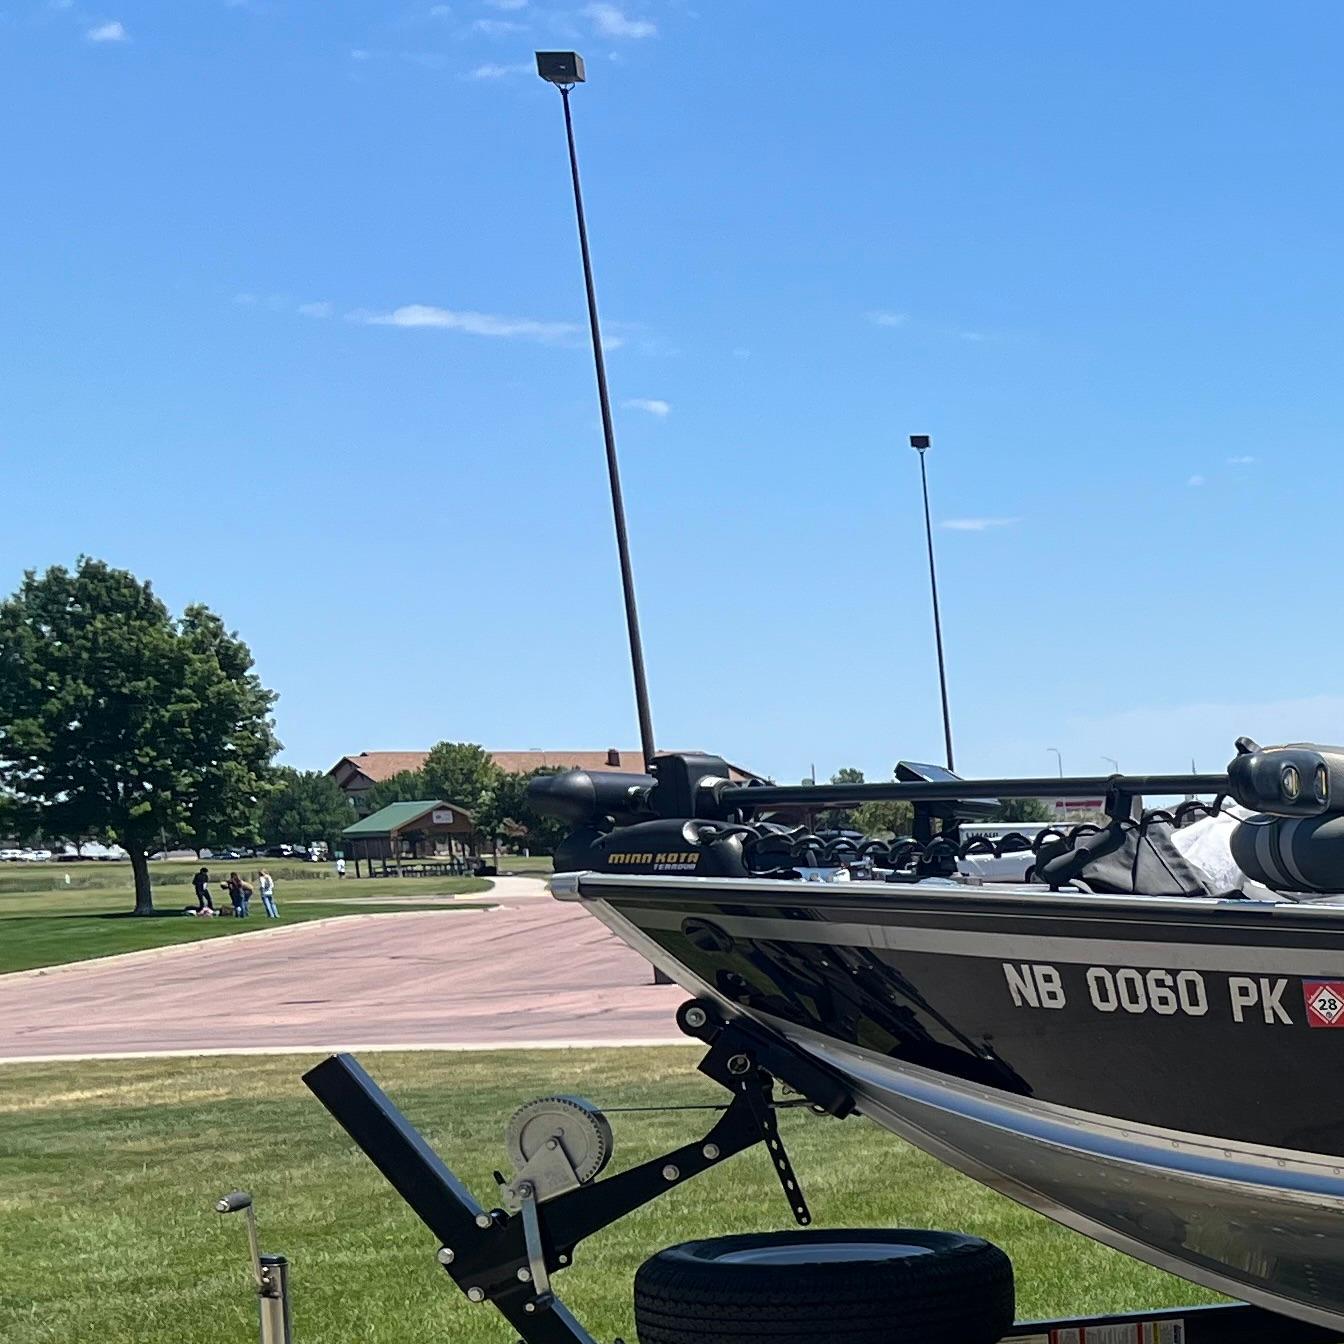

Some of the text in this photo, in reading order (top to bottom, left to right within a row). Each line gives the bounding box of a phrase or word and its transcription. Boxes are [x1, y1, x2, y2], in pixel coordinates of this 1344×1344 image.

[608, 853, 700, 864] MINN KOTA
[1002, 963, 1293, 1025] NB 0060 PK
[1318, 998, 1338, 1011] 28
